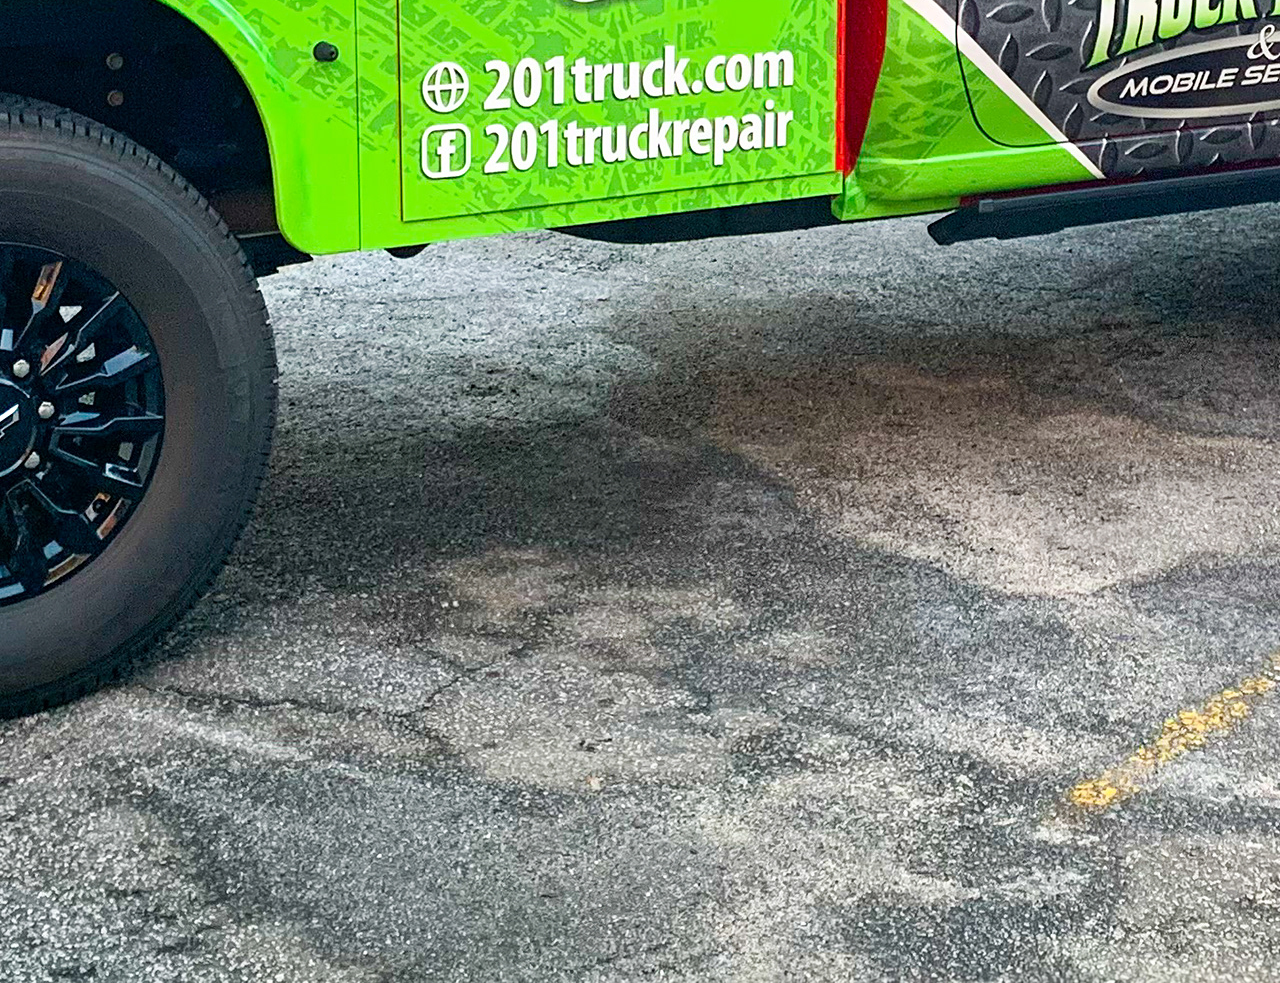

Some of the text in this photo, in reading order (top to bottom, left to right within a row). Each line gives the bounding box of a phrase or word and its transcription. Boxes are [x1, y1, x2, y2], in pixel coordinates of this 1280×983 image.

[482, 44, 795, 112] 201truck.com
[1119, 67, 1239, 100] MOBILE
[482, 100, 794, 175] 201truckrepair
